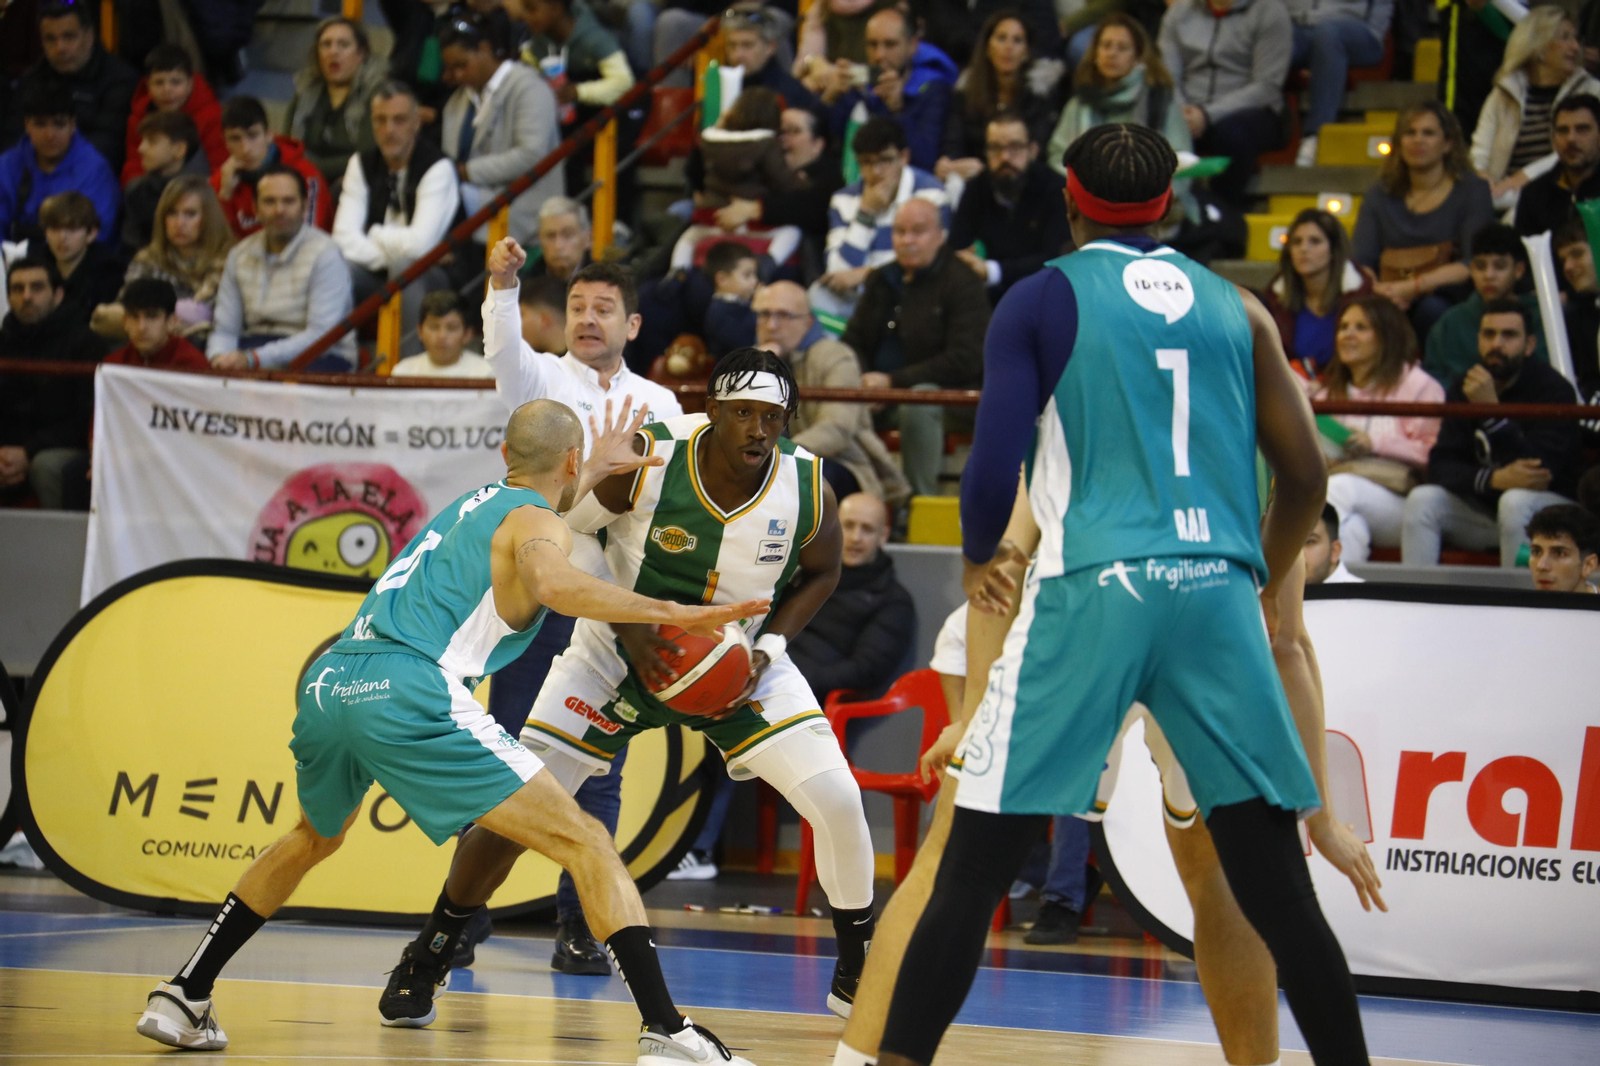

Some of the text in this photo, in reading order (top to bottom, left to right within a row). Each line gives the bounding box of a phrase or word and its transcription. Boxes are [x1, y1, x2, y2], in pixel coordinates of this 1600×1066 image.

[1134, 280, 1184, 292] IDESA
[149, 403, 376, 449] INVESTIGACIÓN
[407, 425, 508, 450] SOLUC
[1155, 348, 1191, 477] 1
[286, 498, 308, 521] A
[311, 478, 351, 506] LA
[360, 479, 415, 535] ELA
[1173, 507, 1211, 542] RAU
[107, 770, 411, 834] MENO
[1385, 847, 1600, 885] INSTALACIONES EL
